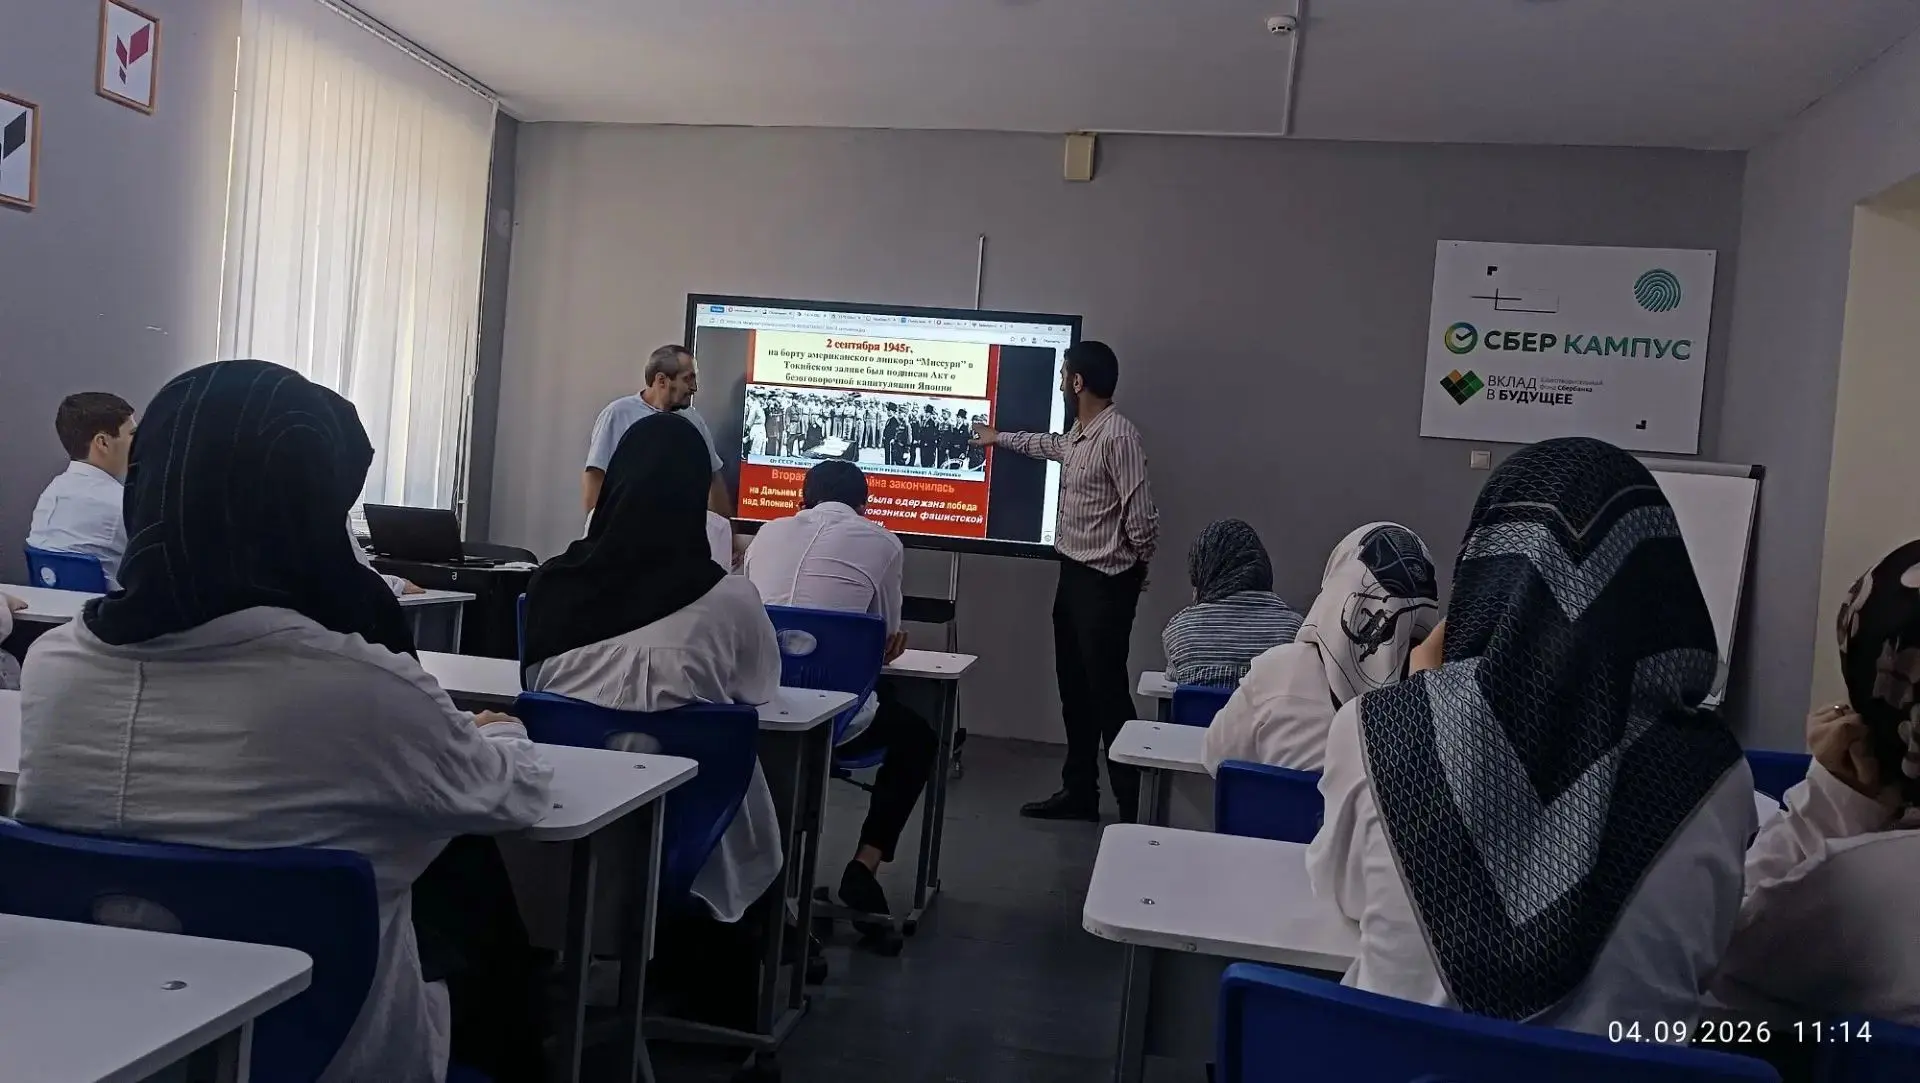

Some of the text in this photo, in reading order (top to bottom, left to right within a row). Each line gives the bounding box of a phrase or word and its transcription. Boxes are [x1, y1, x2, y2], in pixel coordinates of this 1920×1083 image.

[826, 338, 913, 354] 2 сентября 1945г.
[1484, 330, 1692, 361] СБЕР КАМПУС
[780, 348, 806, 359] борту
[808, 352, 875, 362] американского
[876, 357, 914, 366] линкора
[784, 360, 832, 371] Токийском
[834, 365, 865, 374] заливе
[866, 367, 884, 376] был
[886, 370, 928, 379] подписан
[930, 371, 948, 380] Акт
[785, 373, 952, 392] безоговорочной капитуляции Японии
[1488, 375, 1537, 391] ВКЛАД
[1557, 385, 1593, 393] Сбербанка
[1486, 388, 1573, 406] В БУДУЩЕЕ
[749, 486, 760, 494] на
[760, 486, 797, 497] Дальнем
[889, 480, 955, 493] закончилась
[742, 498, 758, 507] над
[760, 497, 794, 509] Японией
[867, 494, 978, 512] была одержана победа
[865, 508, 983, 524] оюзником фашистской
